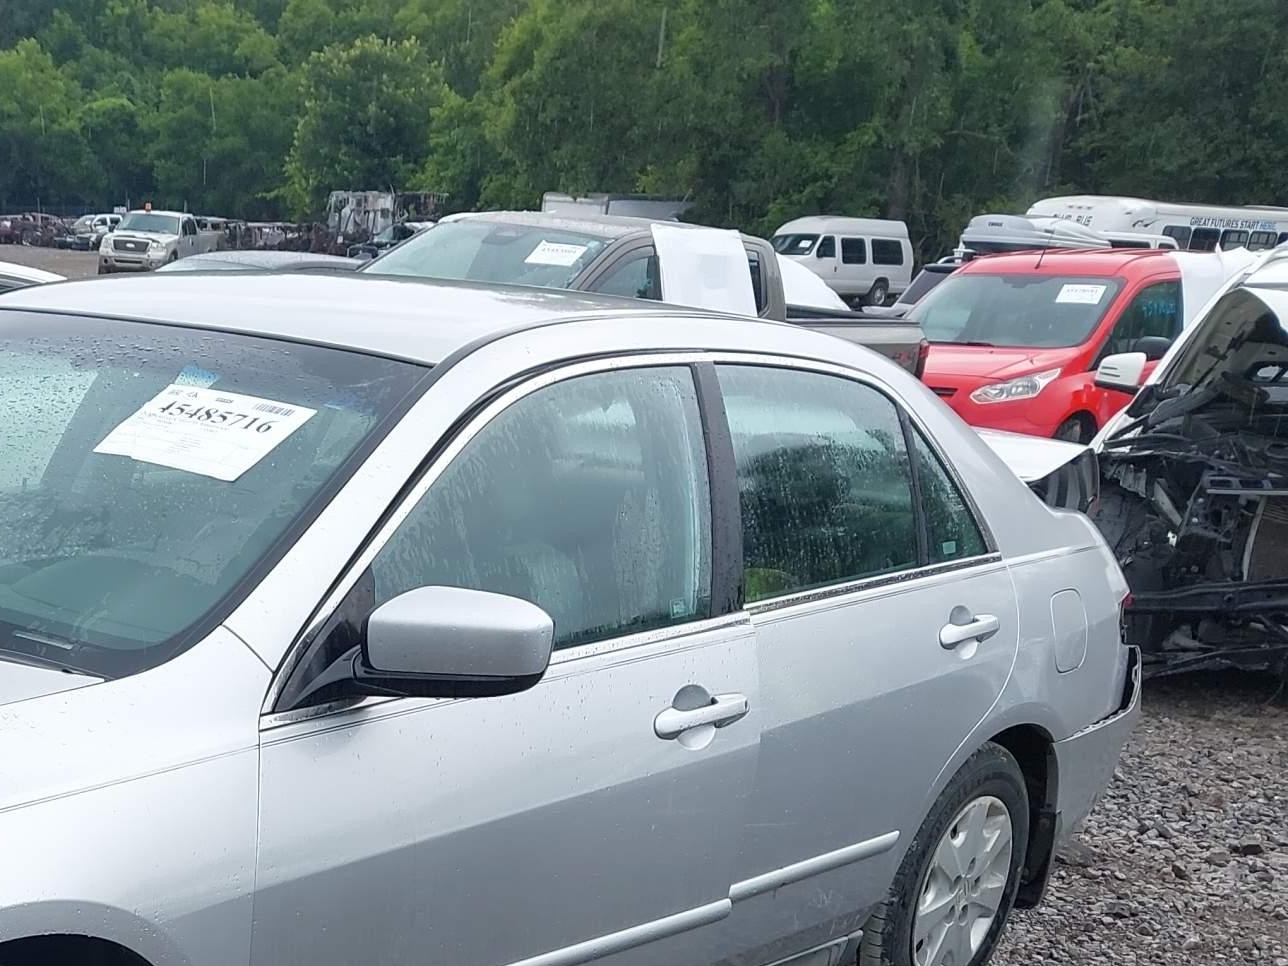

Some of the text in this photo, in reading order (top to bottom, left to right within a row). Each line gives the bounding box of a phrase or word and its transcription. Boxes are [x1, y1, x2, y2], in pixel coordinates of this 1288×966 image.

[1190, 216, 1210, 227] GREAT
[1210, 217, 1238, 228] FUTURES
[1239, 219, 1259, 229] START
[159, 399, 281, 434] 45485716
